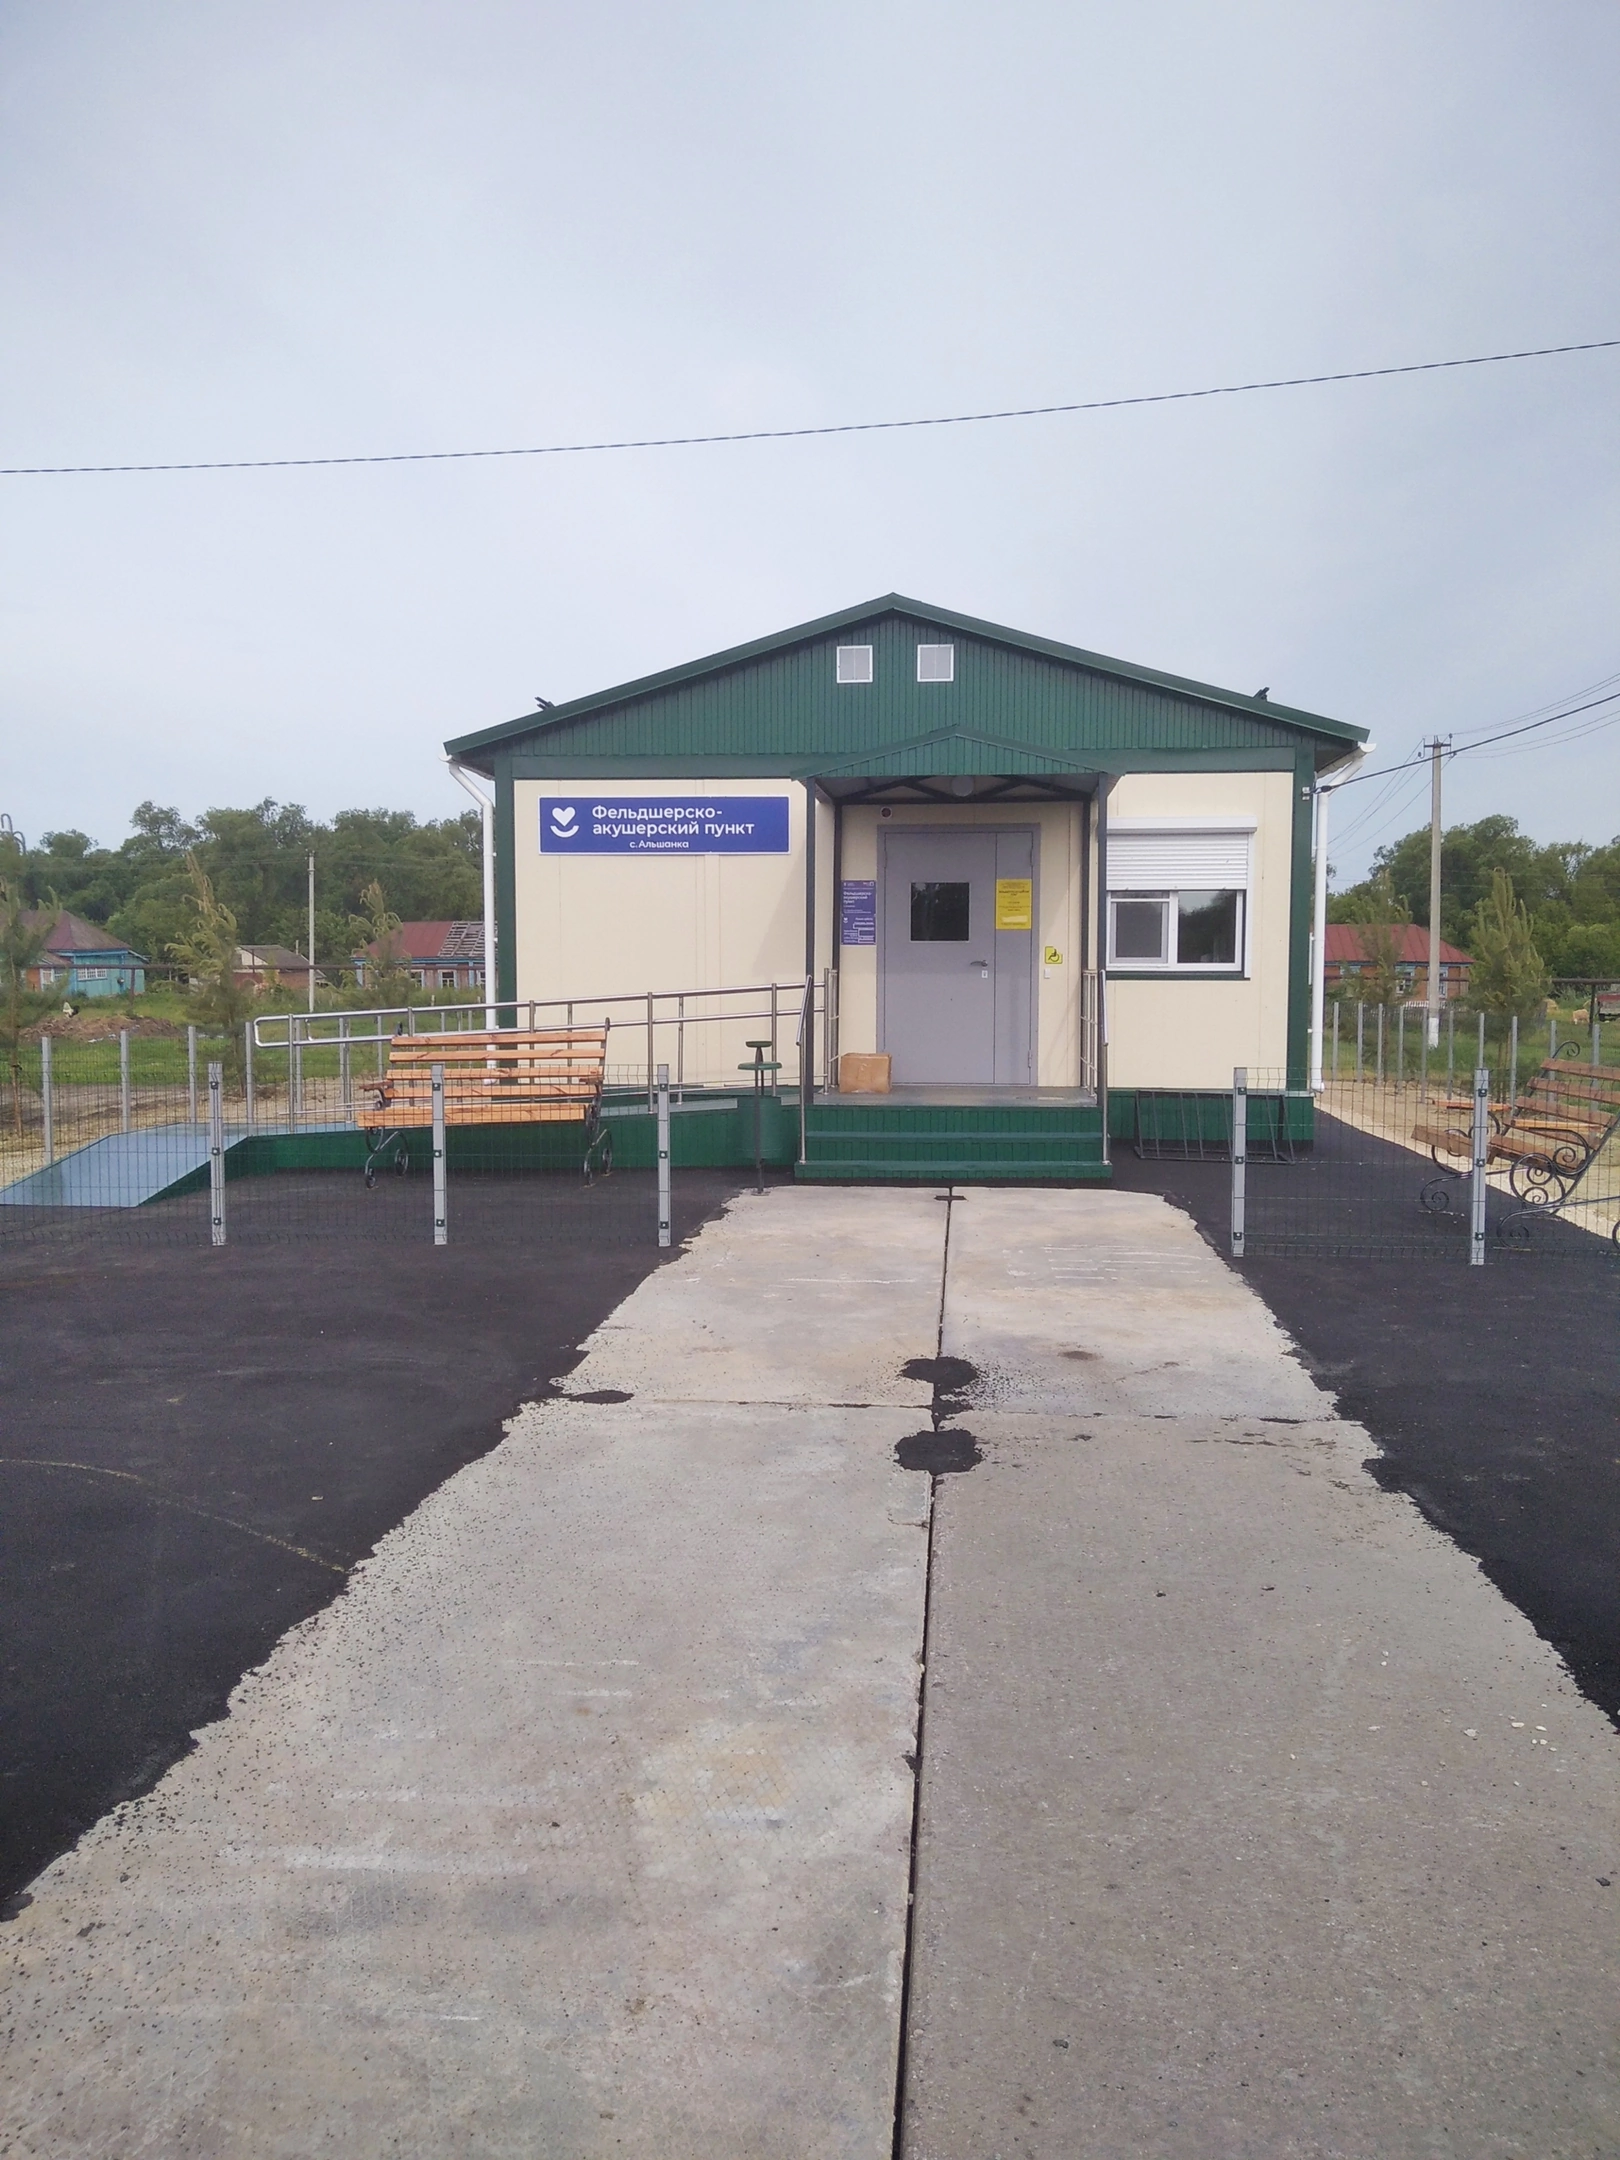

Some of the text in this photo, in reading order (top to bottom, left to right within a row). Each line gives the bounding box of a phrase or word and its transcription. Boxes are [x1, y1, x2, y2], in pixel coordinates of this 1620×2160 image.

[591, 805, 723, 821] Фельдшерско-
[592, 821, 755, 837] акушерский пункт
